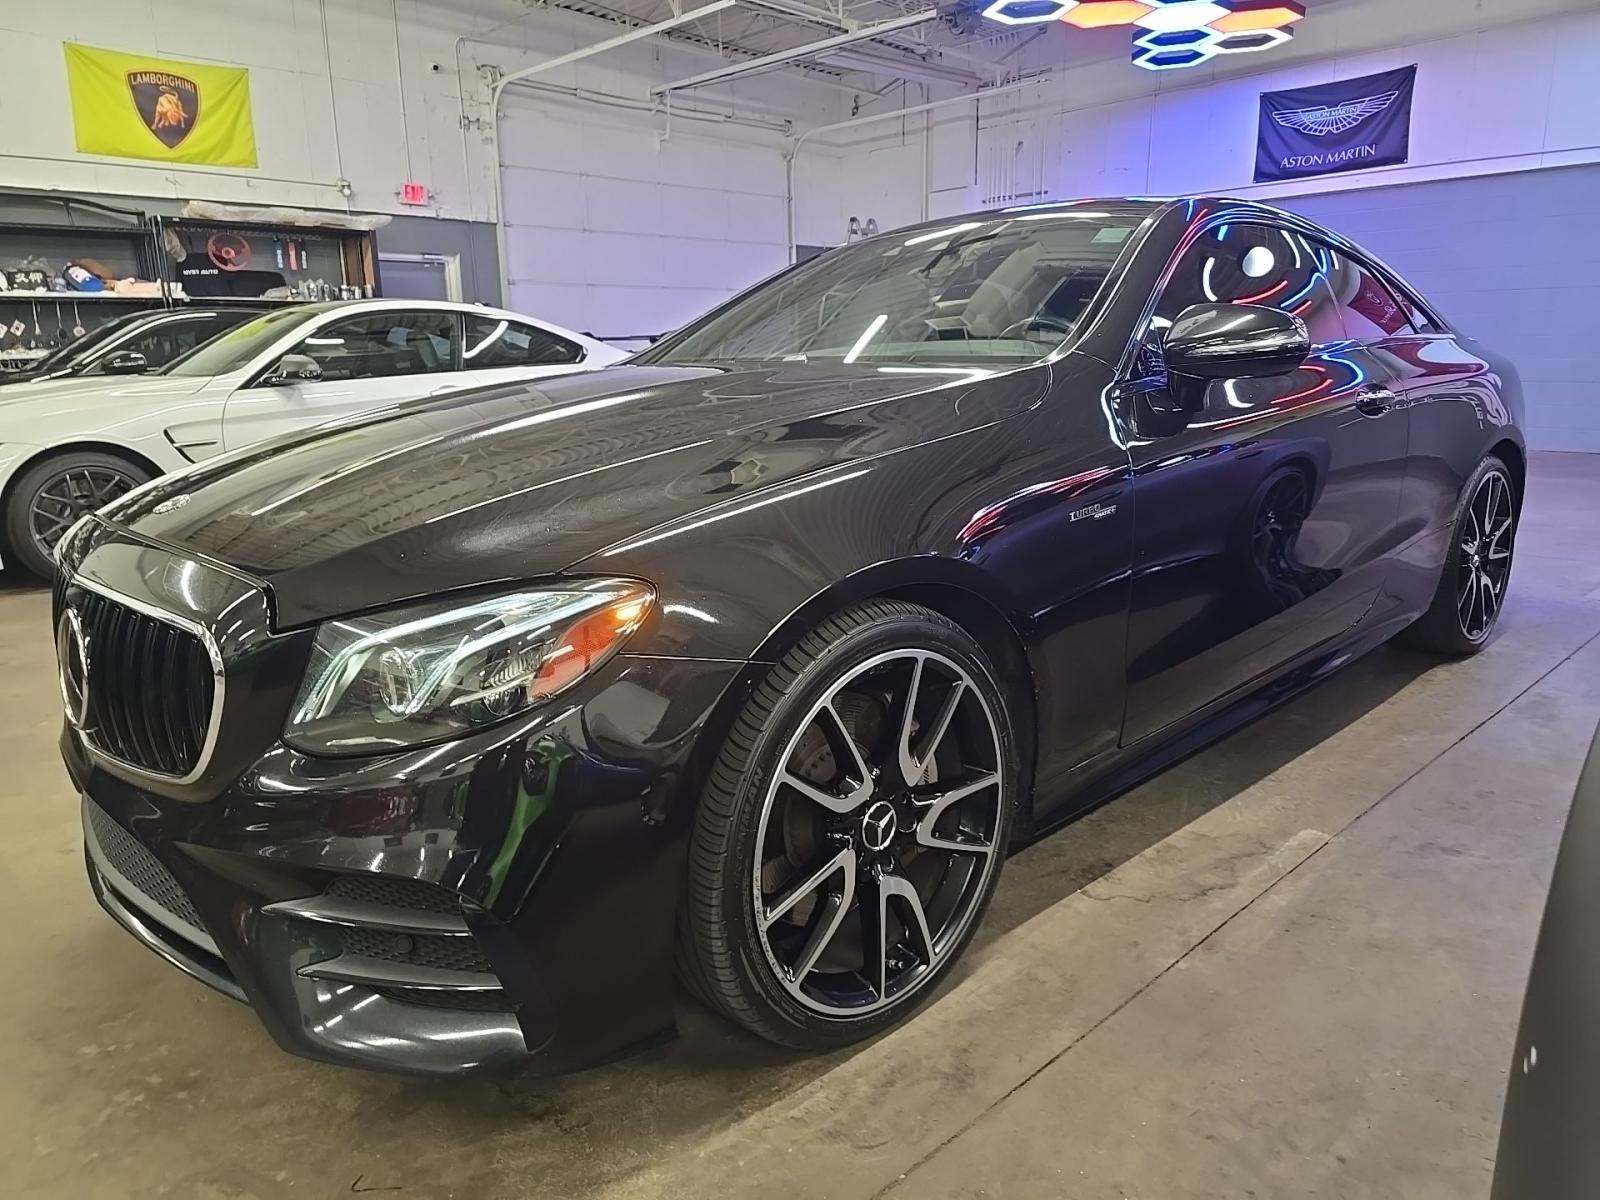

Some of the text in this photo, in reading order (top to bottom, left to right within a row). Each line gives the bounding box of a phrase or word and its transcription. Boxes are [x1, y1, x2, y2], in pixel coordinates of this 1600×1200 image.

[130, 73, 195, 93] LAMBORGHINI
[1280, 144, 1376, 168] ASTON MARTIN
[1069, 503, 1100, 521] TURBO
